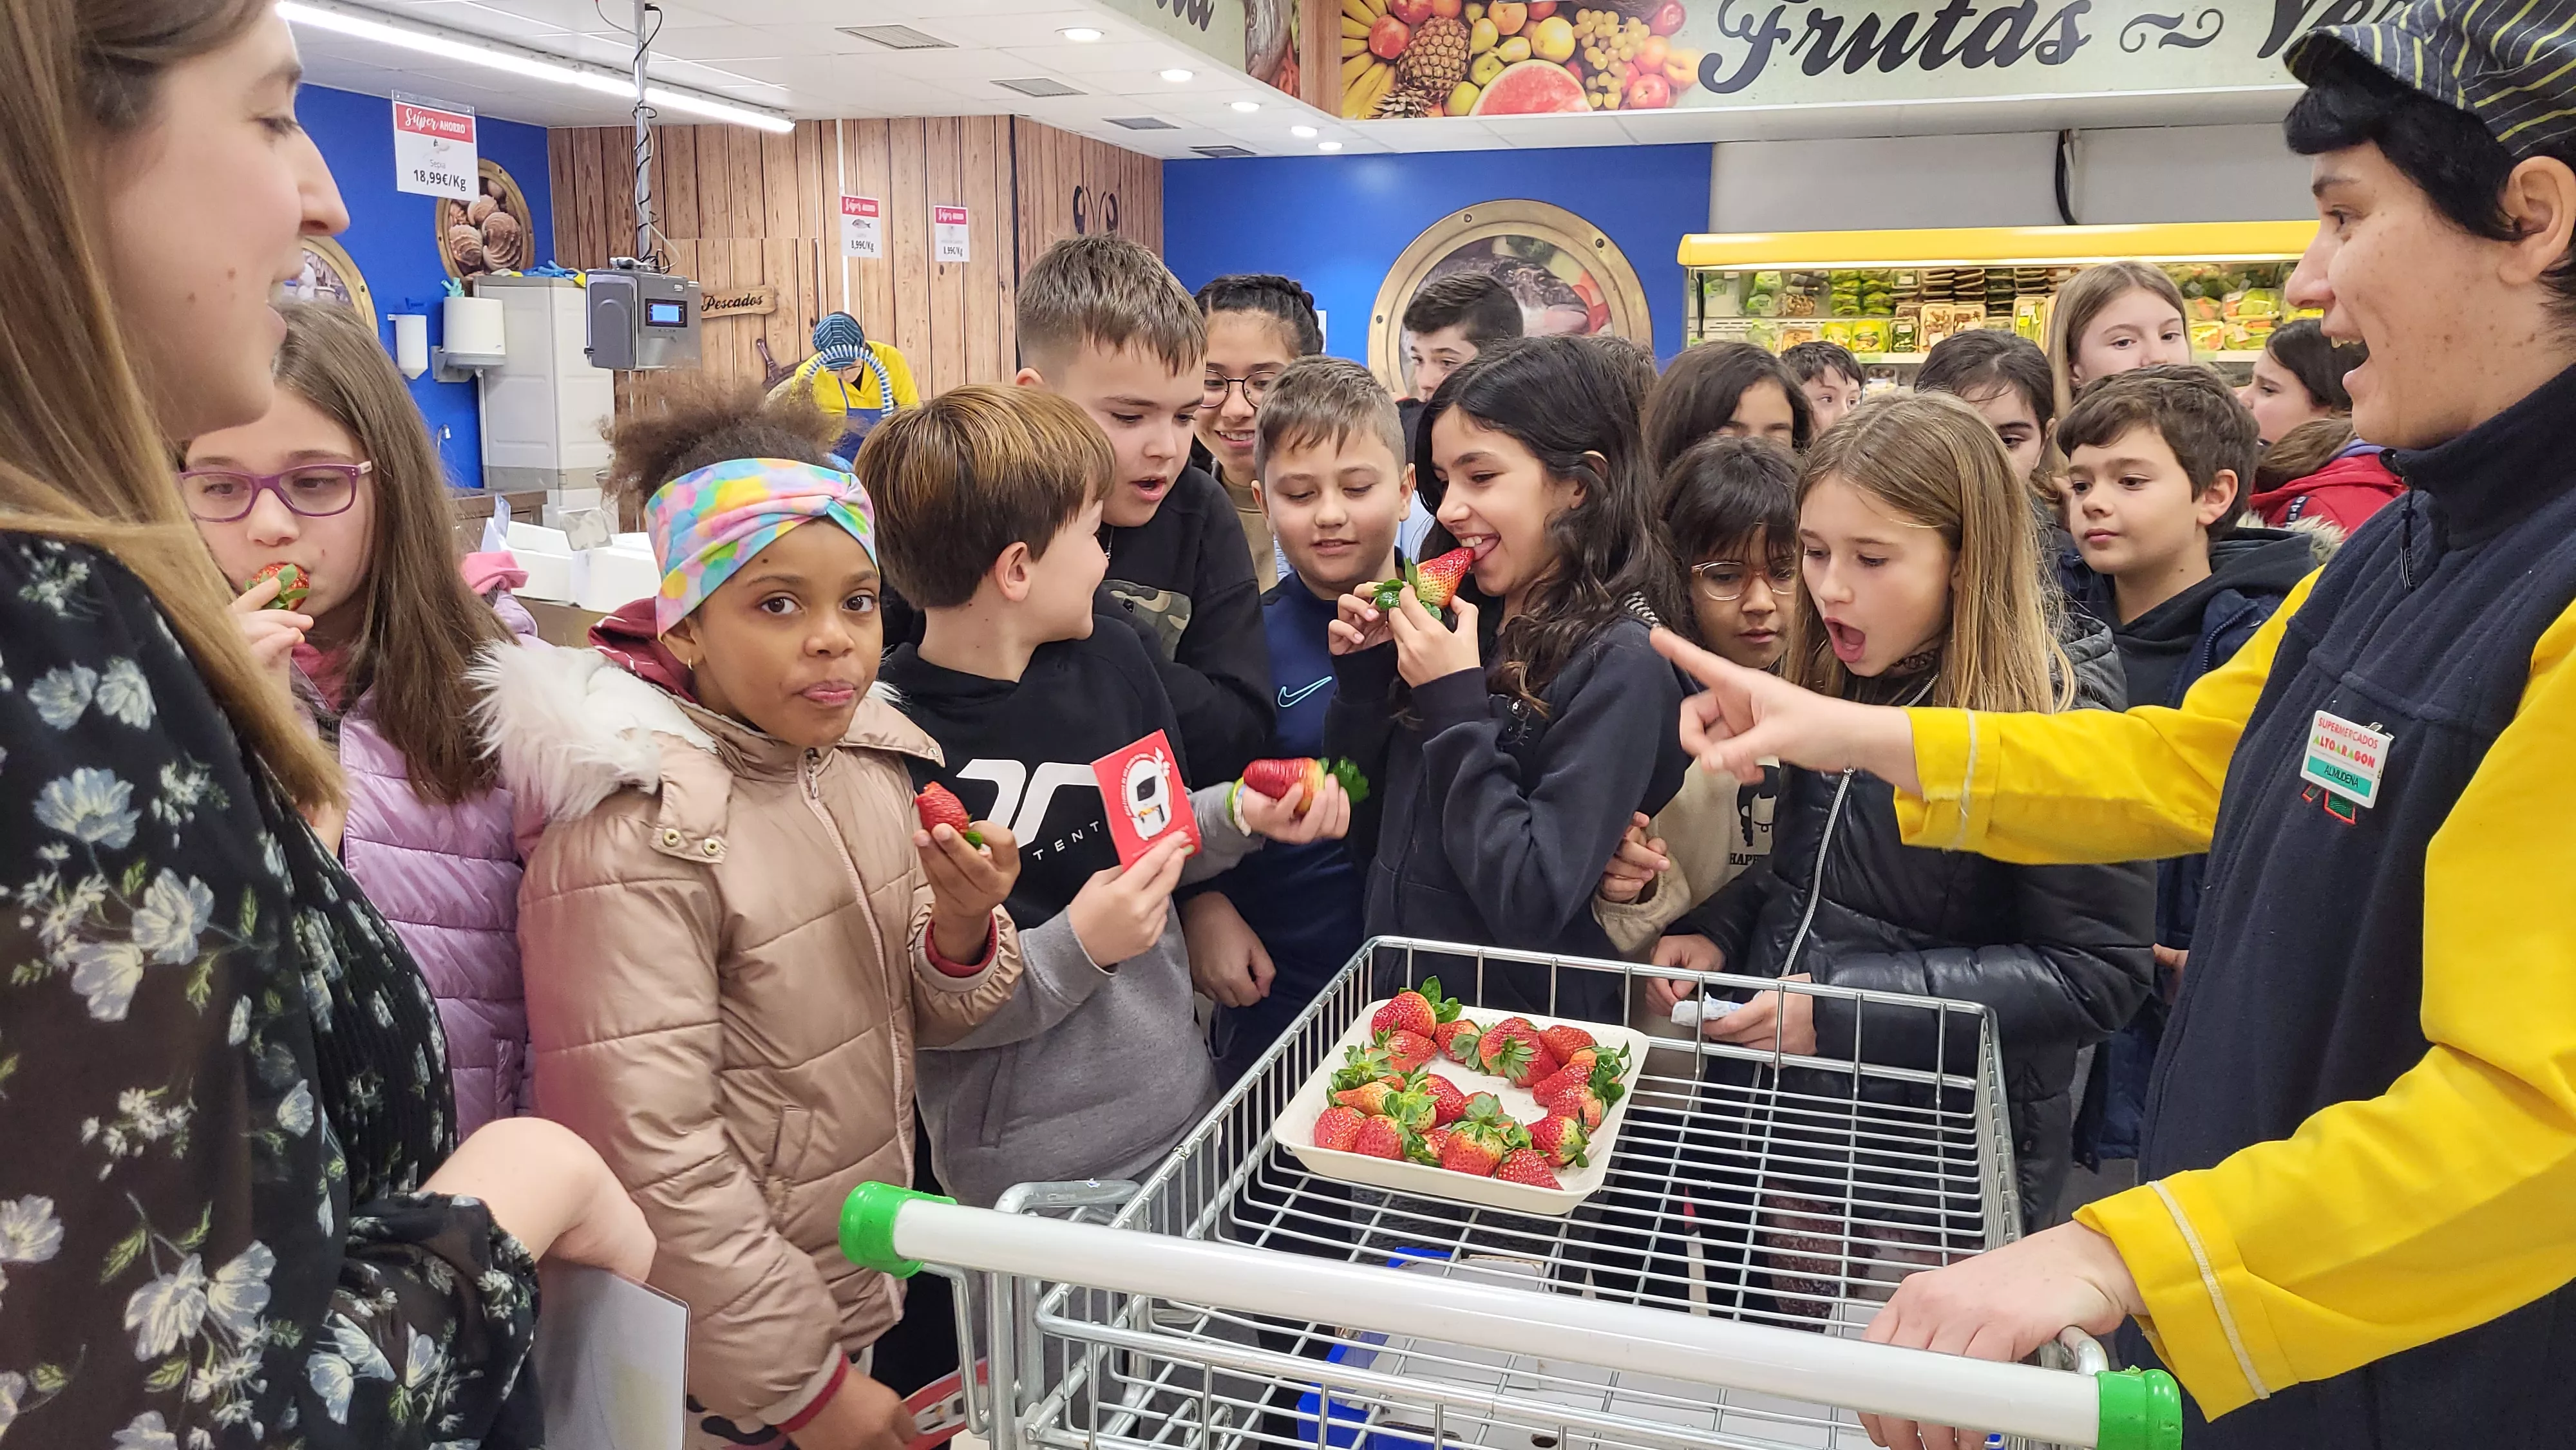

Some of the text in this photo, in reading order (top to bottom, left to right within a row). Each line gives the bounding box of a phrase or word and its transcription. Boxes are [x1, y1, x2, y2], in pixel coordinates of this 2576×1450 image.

[1698, 0, 2092, 94] Frutas
[405, 108, 466, 134] Súper AHORRO
[413, 169, 466, 192] 18,99€/Kg
[701, 292, 763, 312] Pescados
[2318, 717, 2378, 749] SUPERMERCADOS
[2313, 735, 2375, 769] ALTOARAGON
[2324, 765, 2358, 788] ALMUDENA
